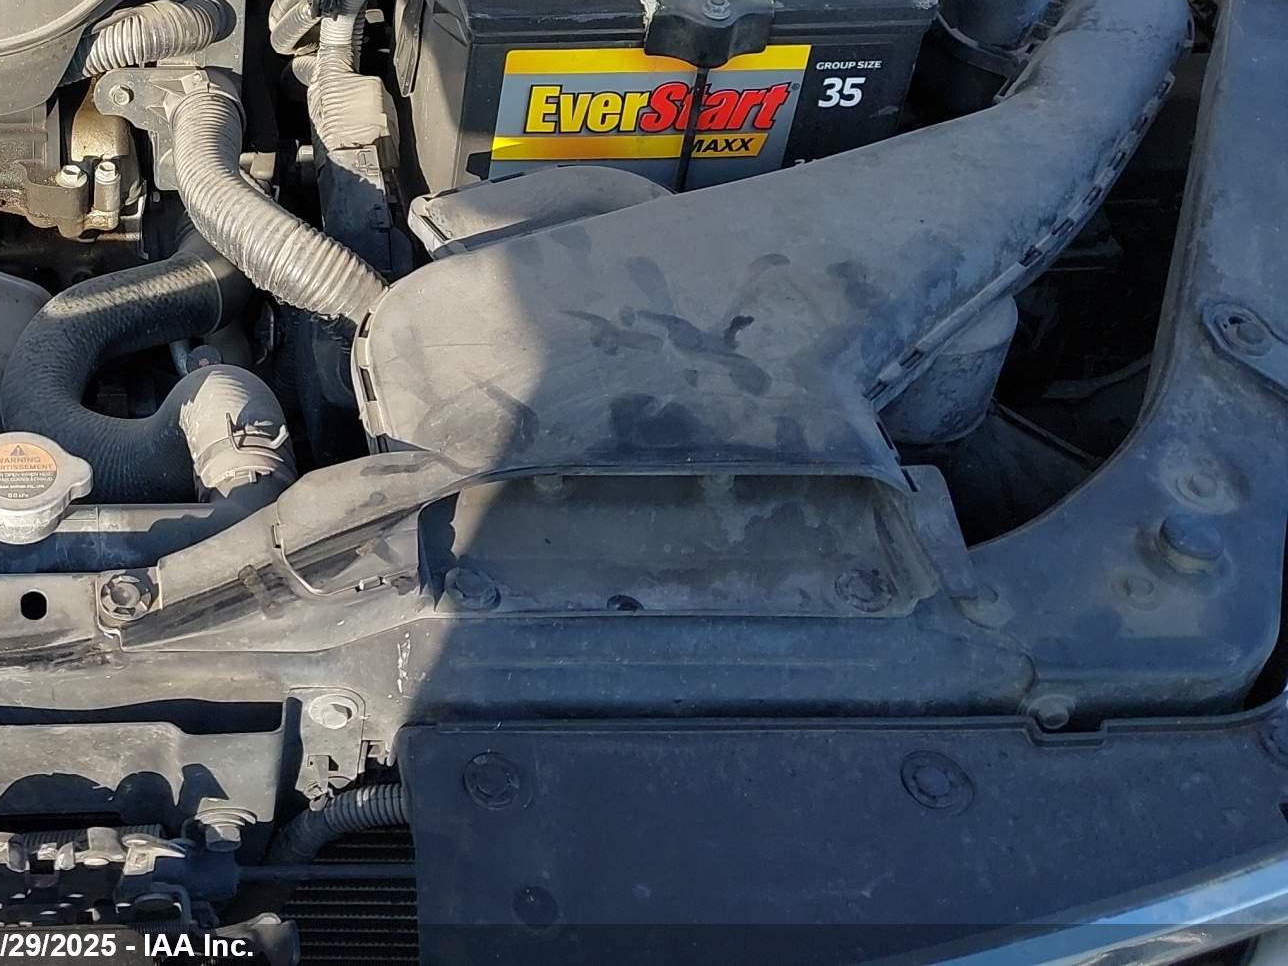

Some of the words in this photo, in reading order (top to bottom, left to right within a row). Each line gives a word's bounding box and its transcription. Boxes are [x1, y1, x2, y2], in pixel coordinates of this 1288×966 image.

[816, 61, 856, 70] GROUP
[857, 60, 882, 69] SIZE
[818, 77, 866, 107] 35
